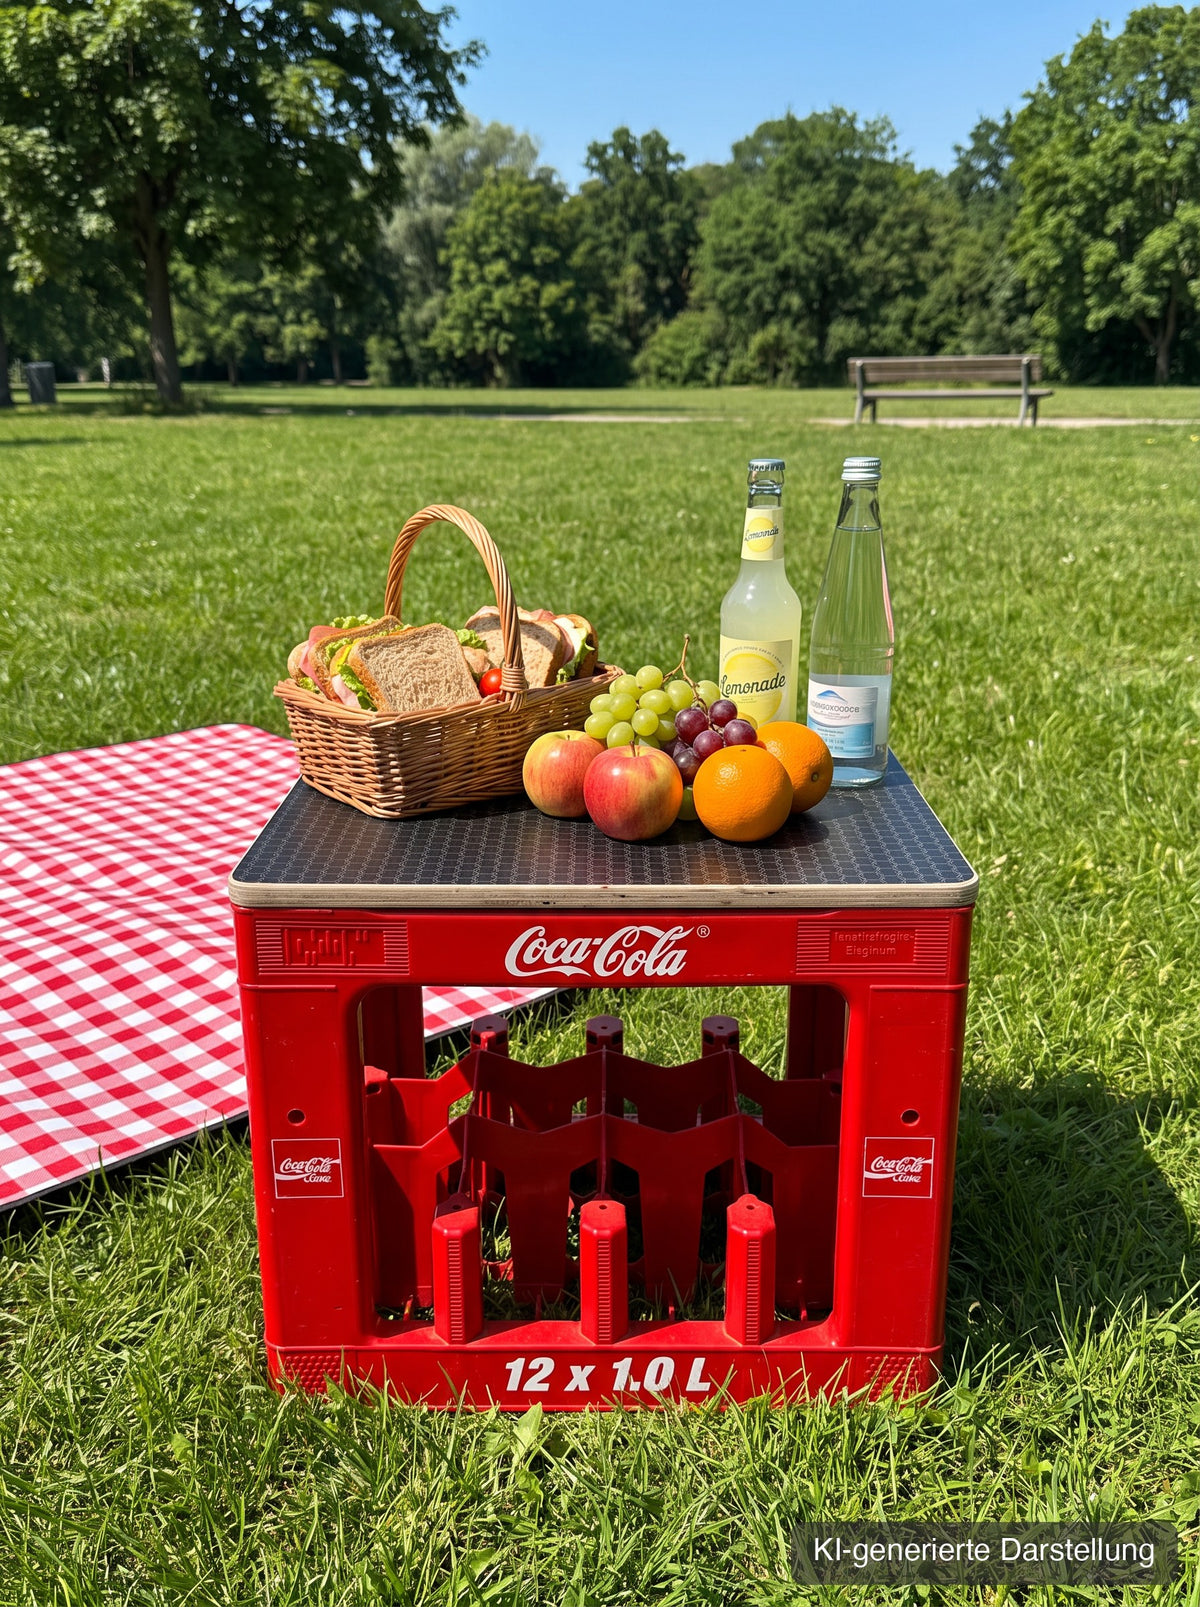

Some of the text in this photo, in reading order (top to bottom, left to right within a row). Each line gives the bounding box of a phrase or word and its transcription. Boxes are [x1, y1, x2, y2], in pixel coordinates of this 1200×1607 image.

[720, 672, 786, 698] Lemonade
[504, 925, 695, 977] Coca-Cola
[279, 1157, 333, 1173] Coca-Cola
[871, 1156, 926, 1173] Coca-Cola
[505, 1356, 711, 1391] 12 x 1.0 L
